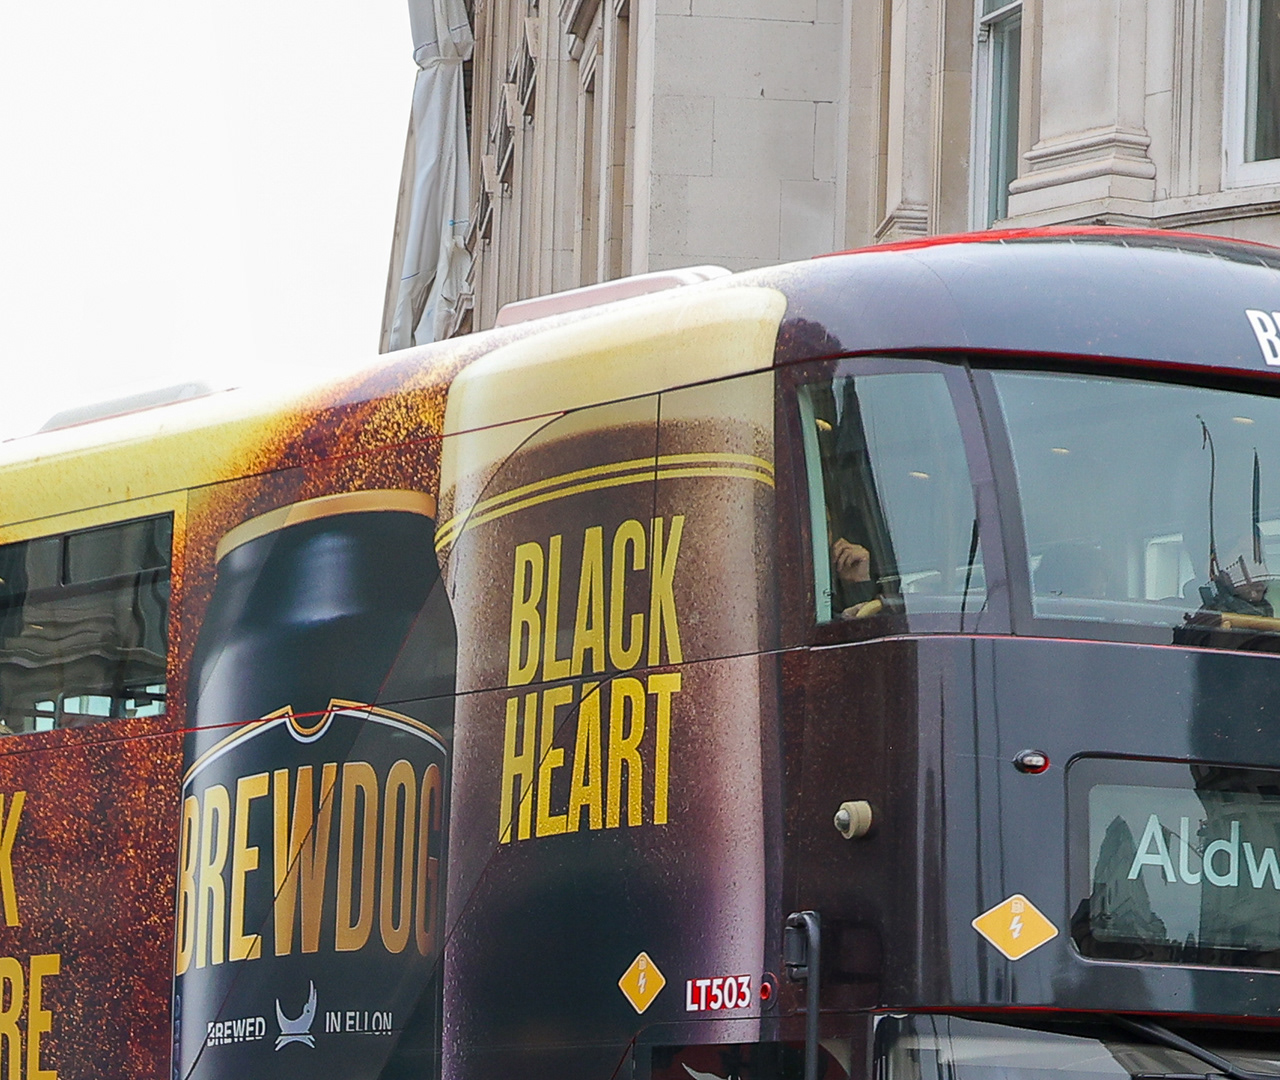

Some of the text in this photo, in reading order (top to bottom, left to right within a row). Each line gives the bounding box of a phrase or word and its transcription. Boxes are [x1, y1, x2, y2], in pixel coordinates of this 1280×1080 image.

[506, 514, 686, 690] BLACK
[498, 672, 682, 845] HEART
[175, 759, 440, 977] BREWDOG
[207, 1011, 393, 1048] BREWED IN ELLON
[685, 975, 751, 1012] LT503
